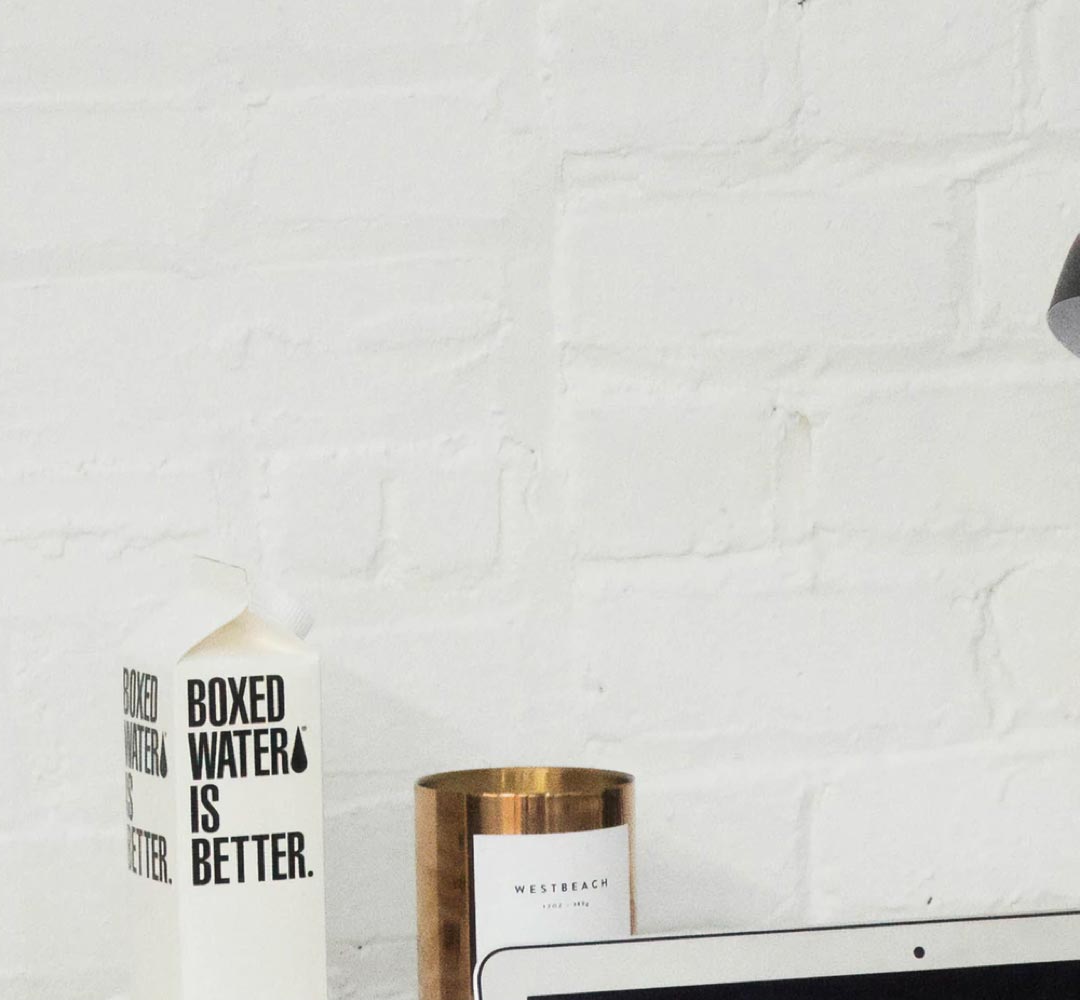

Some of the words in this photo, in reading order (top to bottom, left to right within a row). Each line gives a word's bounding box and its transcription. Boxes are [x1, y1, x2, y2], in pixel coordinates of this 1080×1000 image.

[122, 666, 159, 723] BOXED
[187, 674, 286, 728] BOXED
[187, 727, 290, 781] WATER
[190, 783, 221, 834] IS
[191, 831, 315, 887] BETTER.
[515, 878, 608, 894] WESTBEACH
